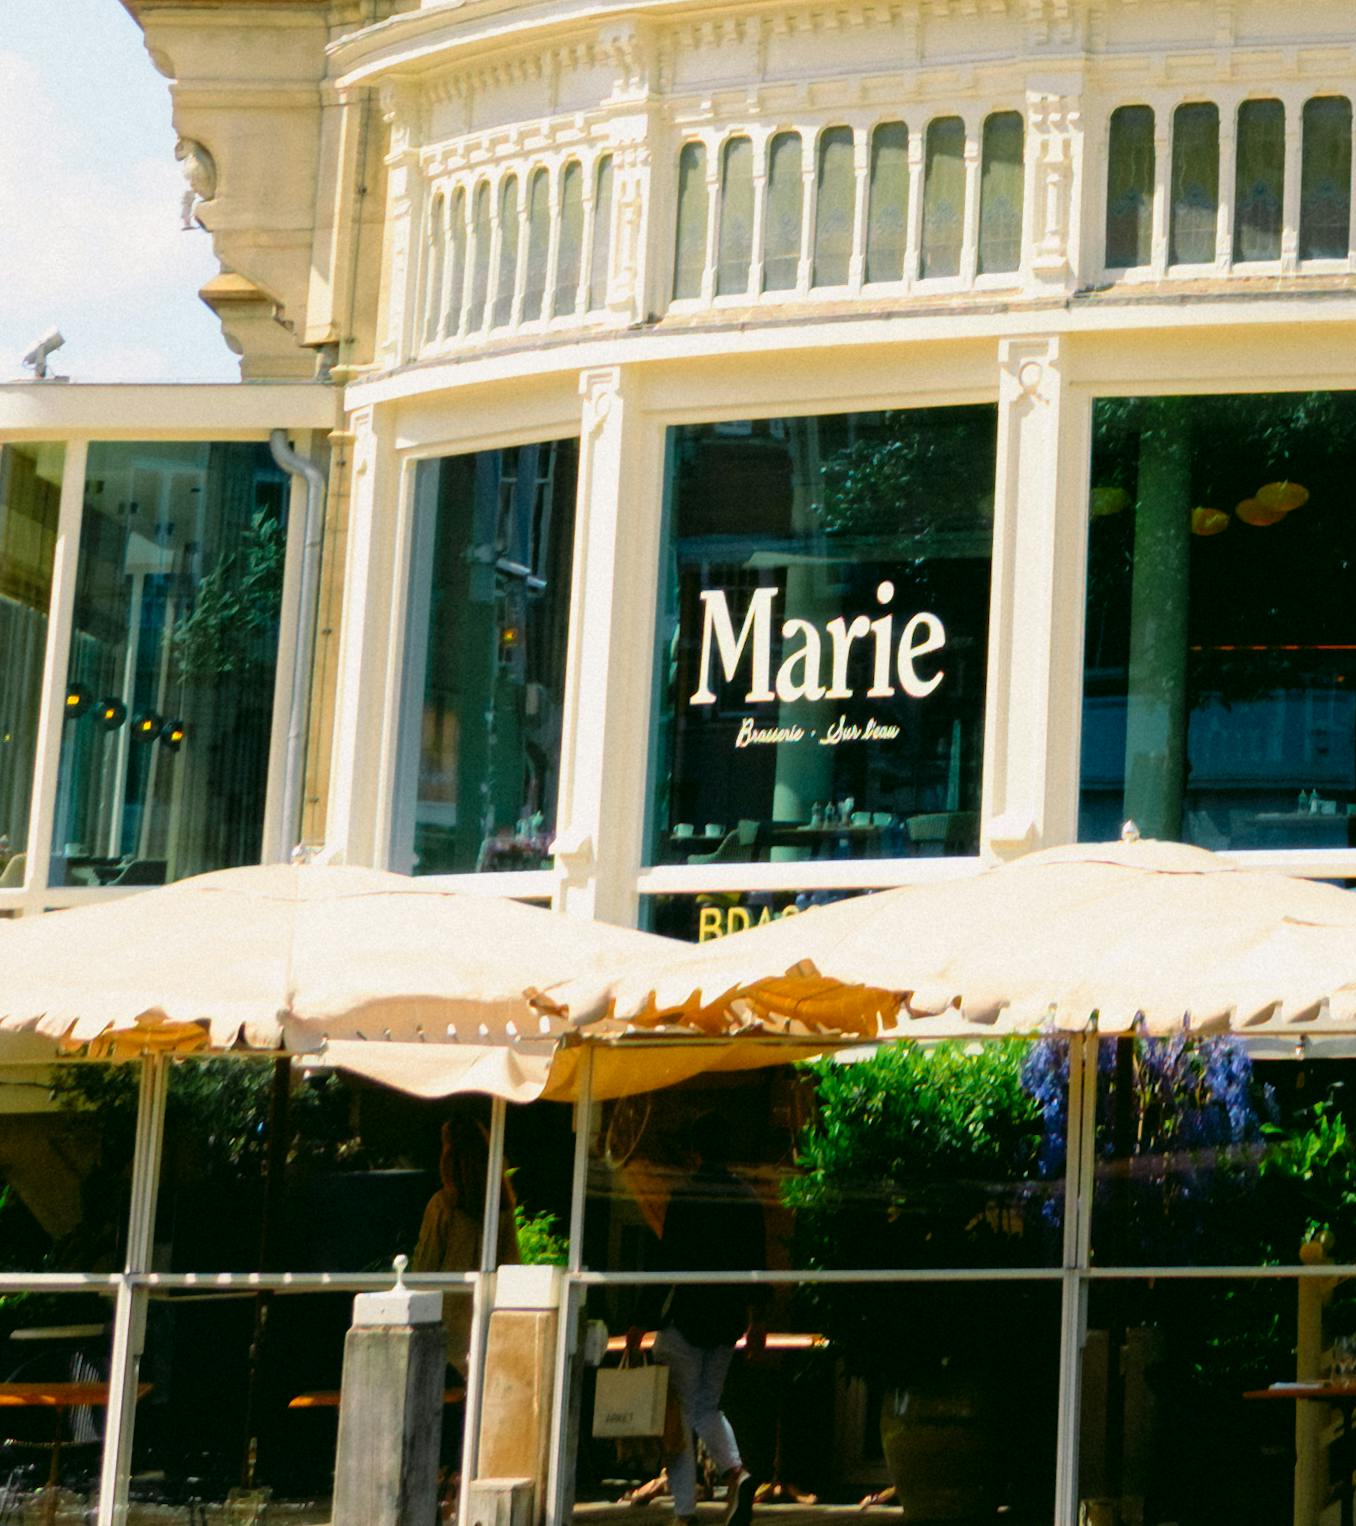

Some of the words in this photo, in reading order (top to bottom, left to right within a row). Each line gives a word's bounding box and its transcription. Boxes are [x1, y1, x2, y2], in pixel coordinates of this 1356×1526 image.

[690, 581, 946, 705] Marie
[735, 717, 805, 748] Brasserie
[819, 714, 862, 745] Sur
